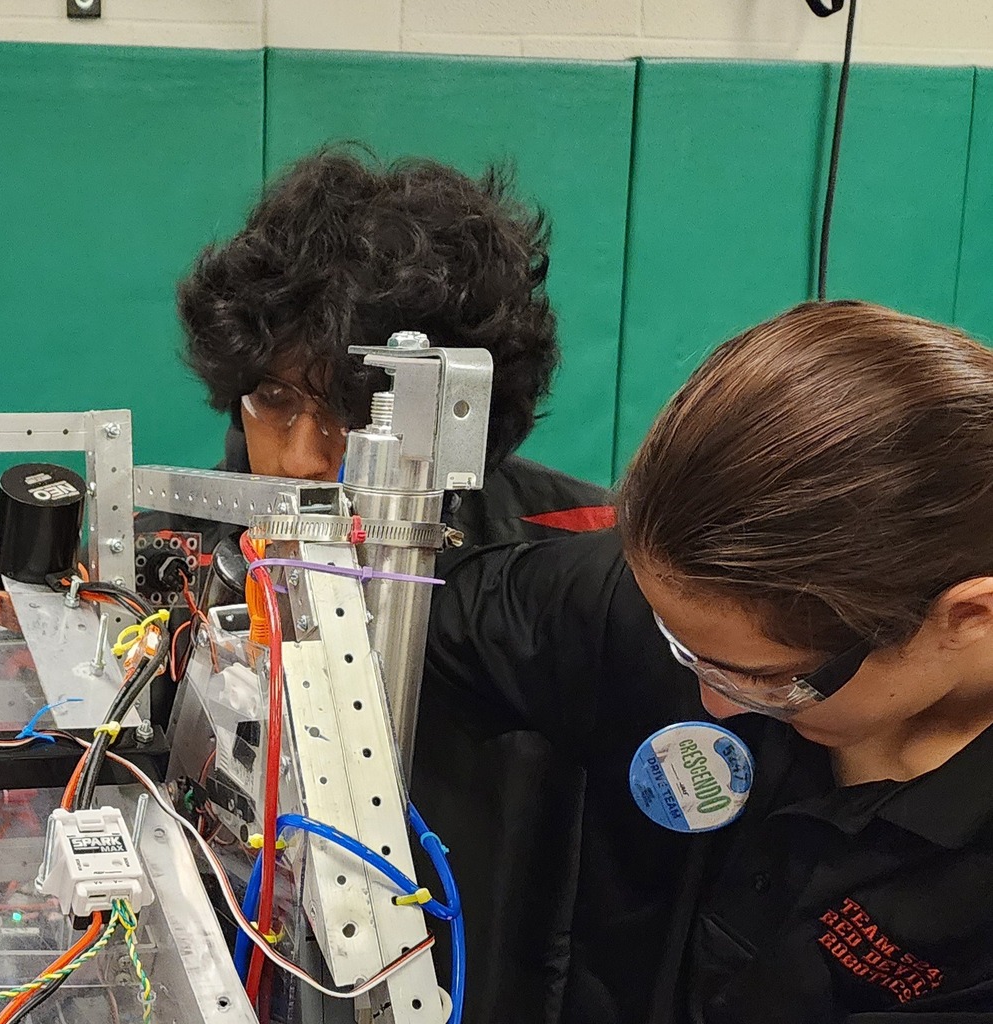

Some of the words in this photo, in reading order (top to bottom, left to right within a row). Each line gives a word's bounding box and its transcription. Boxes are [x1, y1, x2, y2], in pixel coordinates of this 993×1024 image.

[33, 481, 79, 501] NEO
[647, 756, 669, 788] DRIVE
[662, 788, 682, 819] TEAM
[679, 739, 733, 814] CRESCENDO
[71, 836, 122, 848] SPARK
[100, 845, 125, 853] MAX
[819, 908, 863, 947] RED
[840, 897, 901, 957] TEAM
[818, 930, 912, 1004] ROBOTICS
